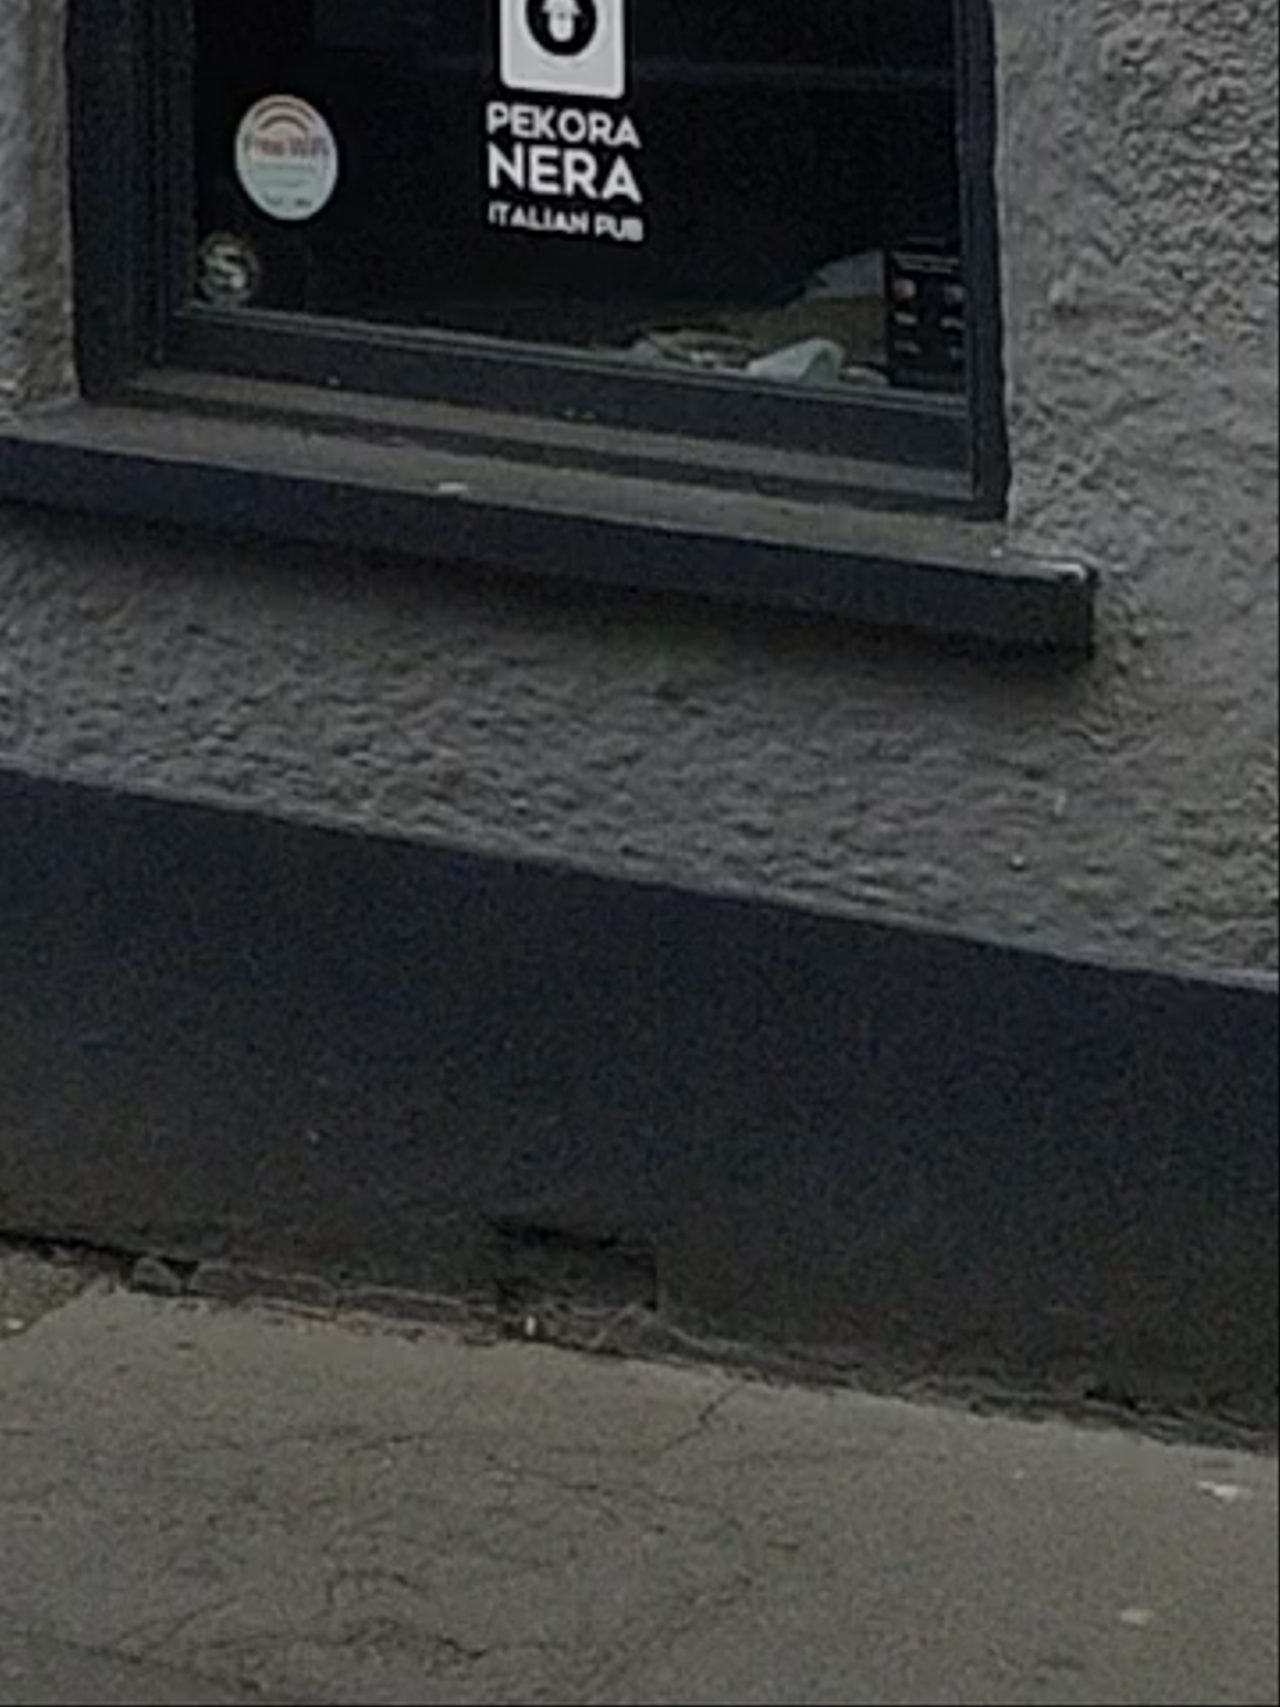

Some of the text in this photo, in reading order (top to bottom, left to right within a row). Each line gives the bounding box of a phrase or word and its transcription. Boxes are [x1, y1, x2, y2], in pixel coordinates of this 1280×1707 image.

[486, 100, 641, 150] PEKORA
[487, 140, 643, 204] NERA
[488, 200, 644, 243] ITALIAN PUB
